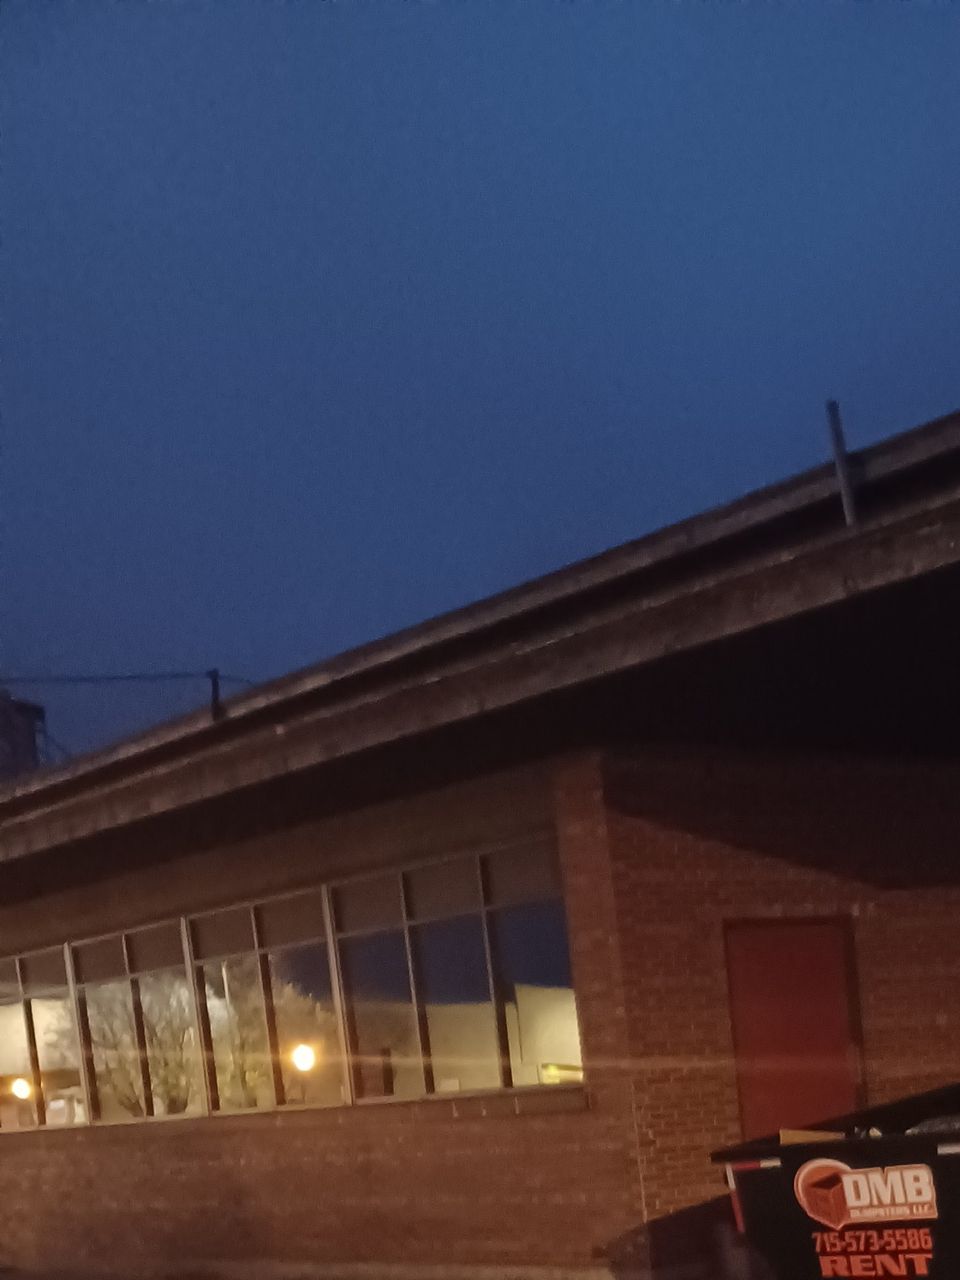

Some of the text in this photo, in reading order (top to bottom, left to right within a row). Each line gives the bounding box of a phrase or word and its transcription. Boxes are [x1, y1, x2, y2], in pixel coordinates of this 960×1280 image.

[842, 1169, 931, 1206] DMB
[811, 1227, 933, 1253] 715-573-5586
[819, 1253, 933, 1278] RENT
